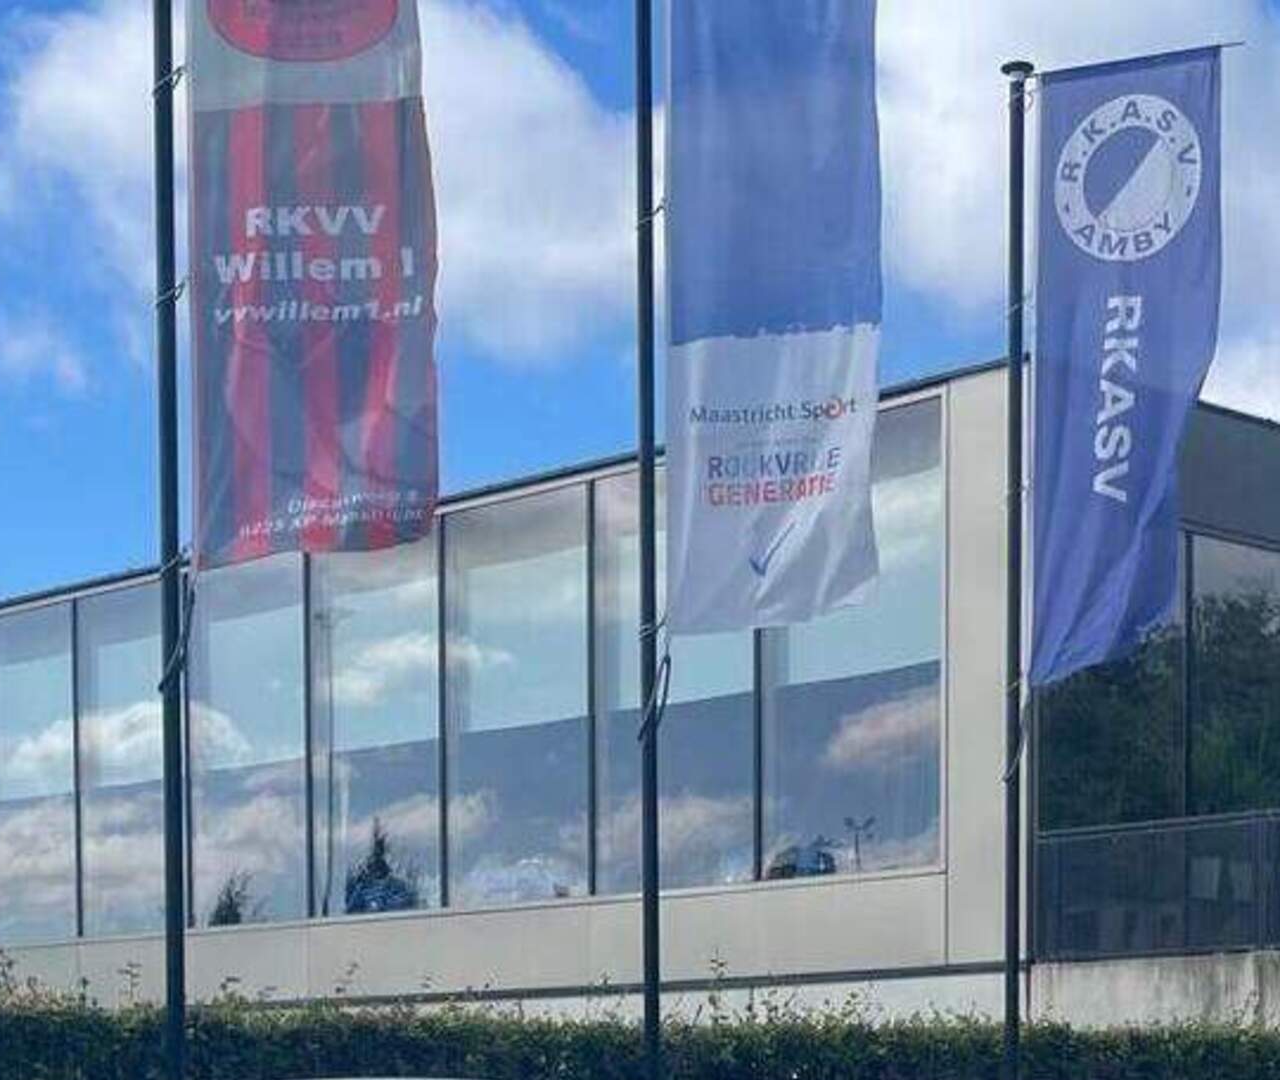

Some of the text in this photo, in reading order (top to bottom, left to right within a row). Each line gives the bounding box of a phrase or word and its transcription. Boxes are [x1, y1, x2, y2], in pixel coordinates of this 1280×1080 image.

[245, 204, 386, 237] RKVV
[1074, 212, 1173, 255] AMBY
[214, 251, 382, 283] Willem
[690, 396, 856, 424] Maastricht Sport
[1091, 296, 1142, 503] RKASV
